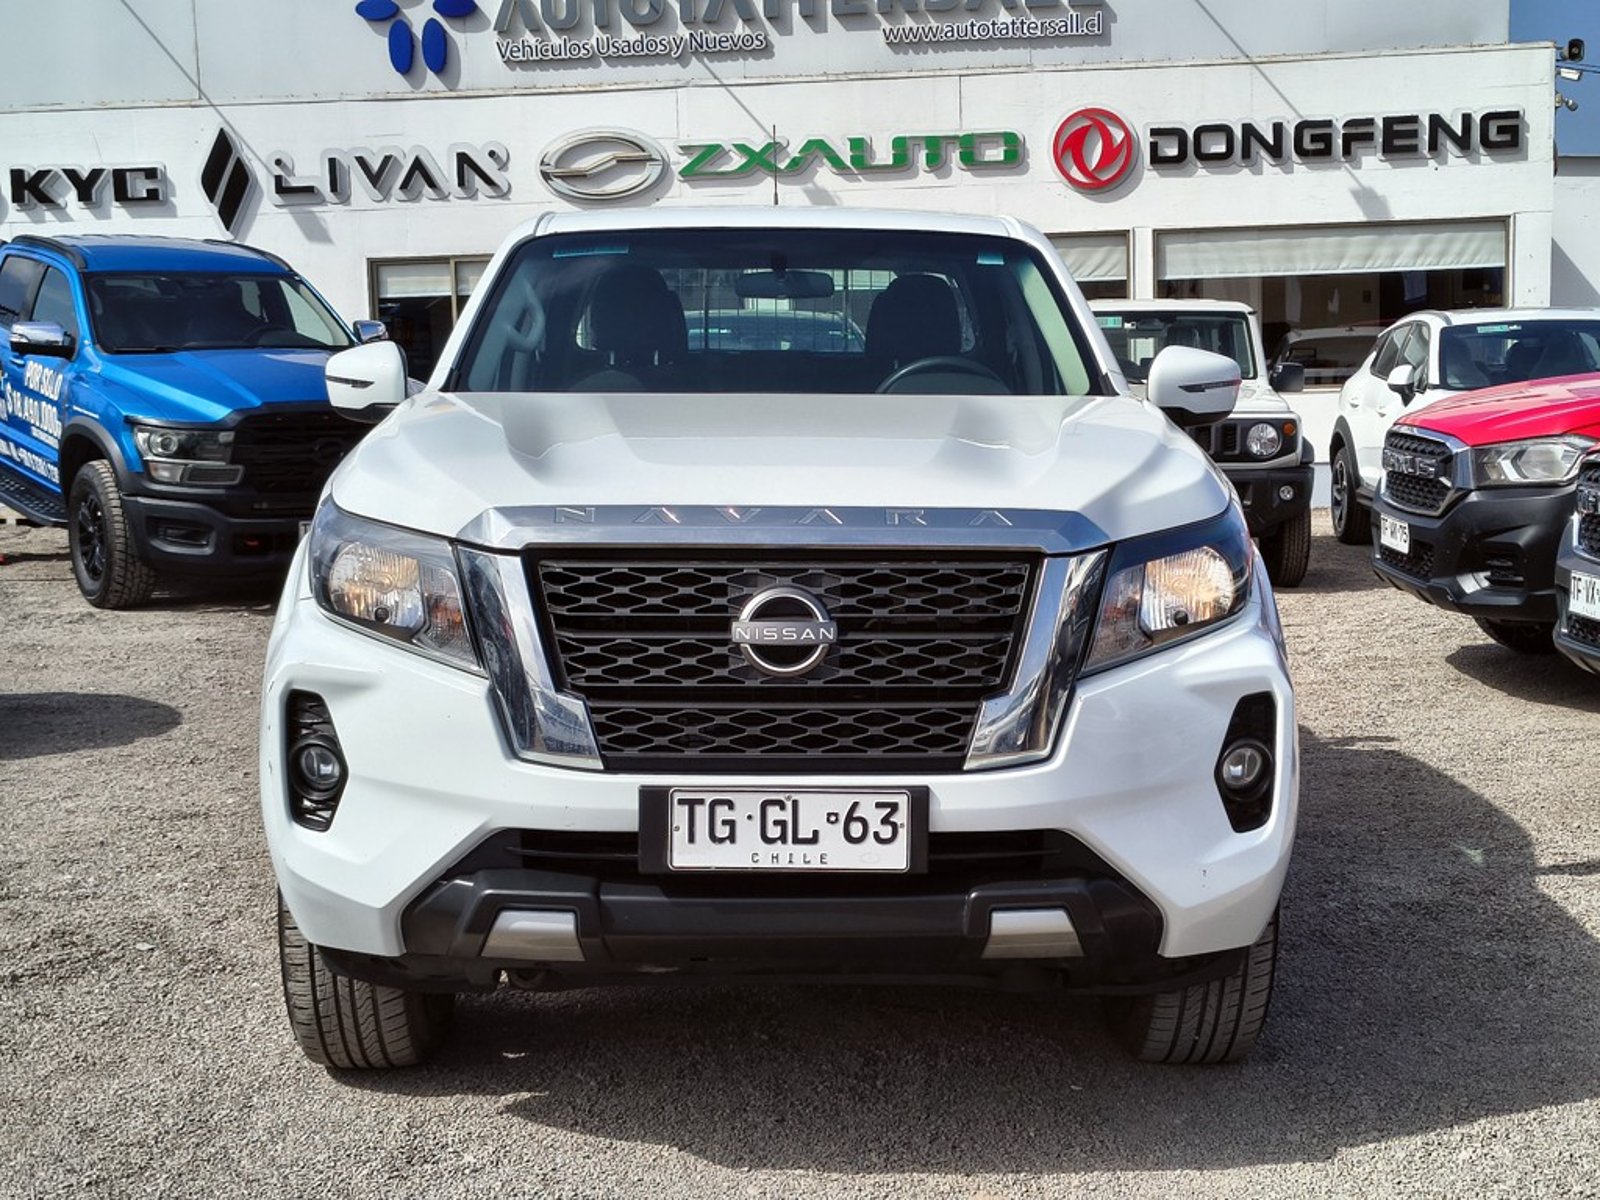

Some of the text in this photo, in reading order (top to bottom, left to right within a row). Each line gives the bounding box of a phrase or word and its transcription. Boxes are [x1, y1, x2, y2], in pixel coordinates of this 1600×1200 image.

[883, 12, 1102, 43] www.autotattersall.cl
[496, 31, 765, 60] Vehículos Usados y Nuevos
[1149, 110, 1521, 165] DONGFENG
[677, 131, 1021, 177] ZXAUTO
[9, 167, 160, 204] KYC
[273, 149, 503, 195] LIVAN
[555, 506, 1013, 526] NAVARA
[735, 626, 836, 641] NISSAN
[750, 852, 829, 865] CHILE
